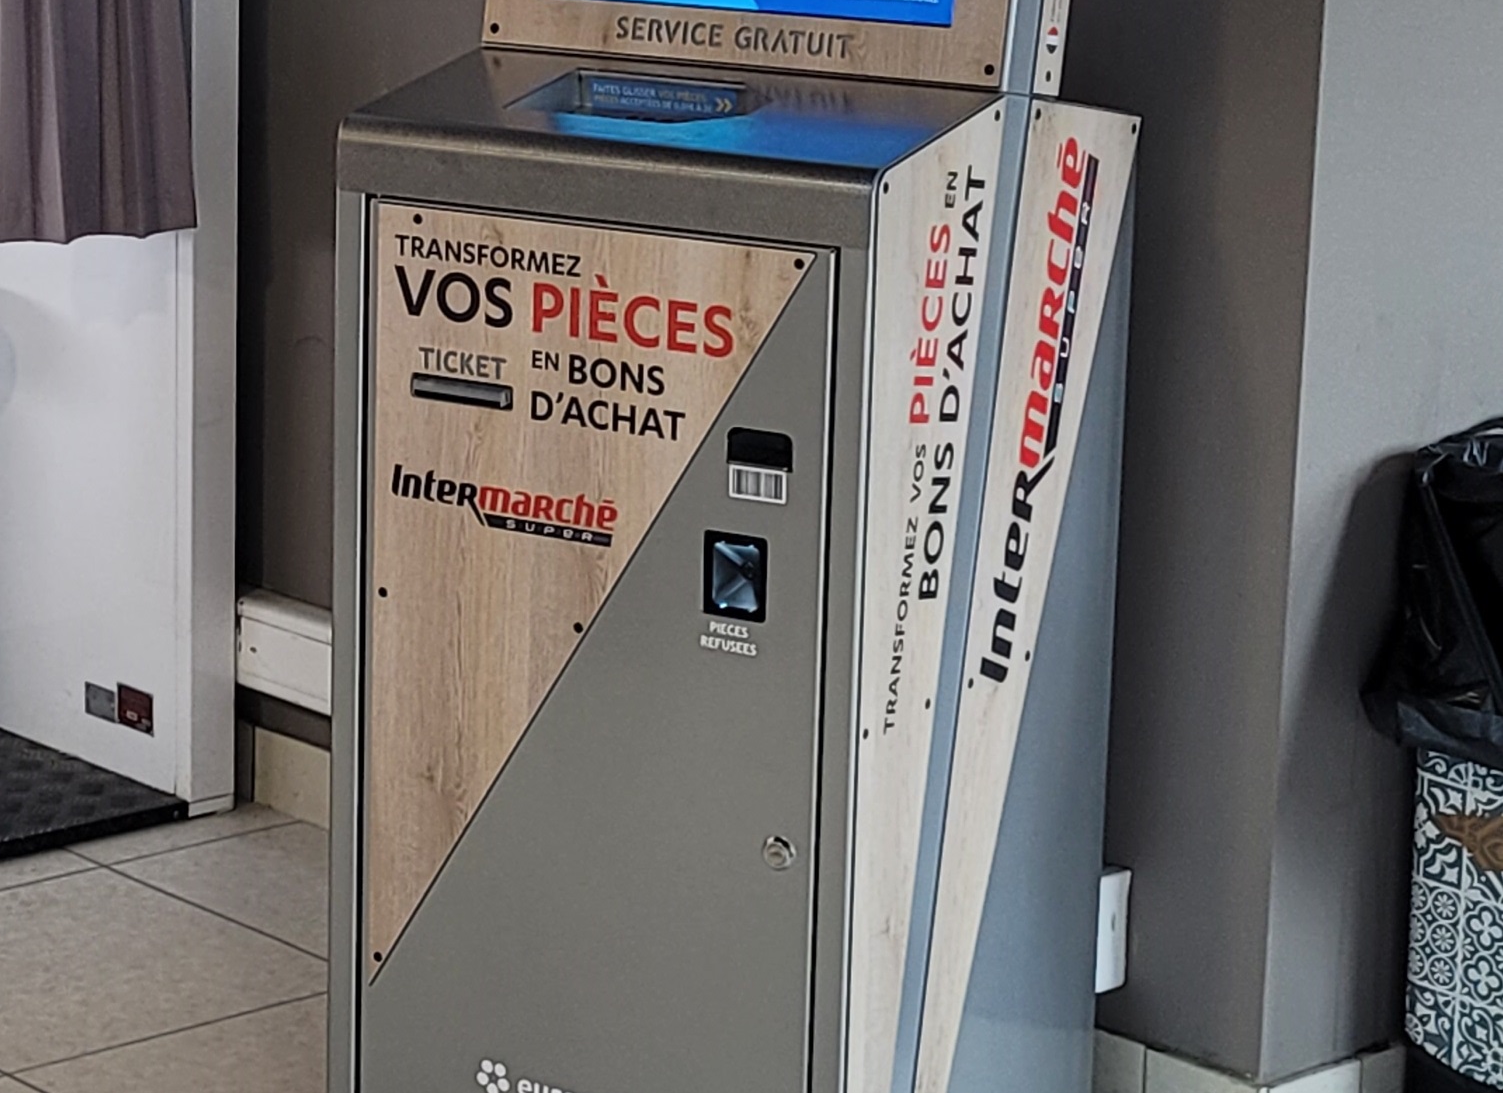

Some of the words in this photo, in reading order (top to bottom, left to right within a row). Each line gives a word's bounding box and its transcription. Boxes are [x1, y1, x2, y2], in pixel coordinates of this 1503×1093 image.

[616, 15, 724, 48] SERVICE
[734, 26, 856, 59] GRATUIT
[944, 171, 959, 209] EN
[395, 233, 581, 278] TRANSFORMEZ
[394, 264, 513, 328] VOS
[531, 274, 736, 359] PIÈCES
[909, 224, 951, 424] PIÈCES
[418, 346, 507, 380] TICKET
[531, 350, 560, 372] EN
[568, 354, 665, 396] BONS
[918, 442, 954, 600] BONS
[939, 165, 986, 423] D’ACHAT
[530, 390, 686, 441] D’ACHAT
[979, 137, 1086, 683] Intermarché
[392, 464, 618, 532] Intermarché
[909, 444, 926, 503] VOS
[505, 518, 594, 543] SUPER
[883, 516, 918, 735] TRANSFORMEZ
